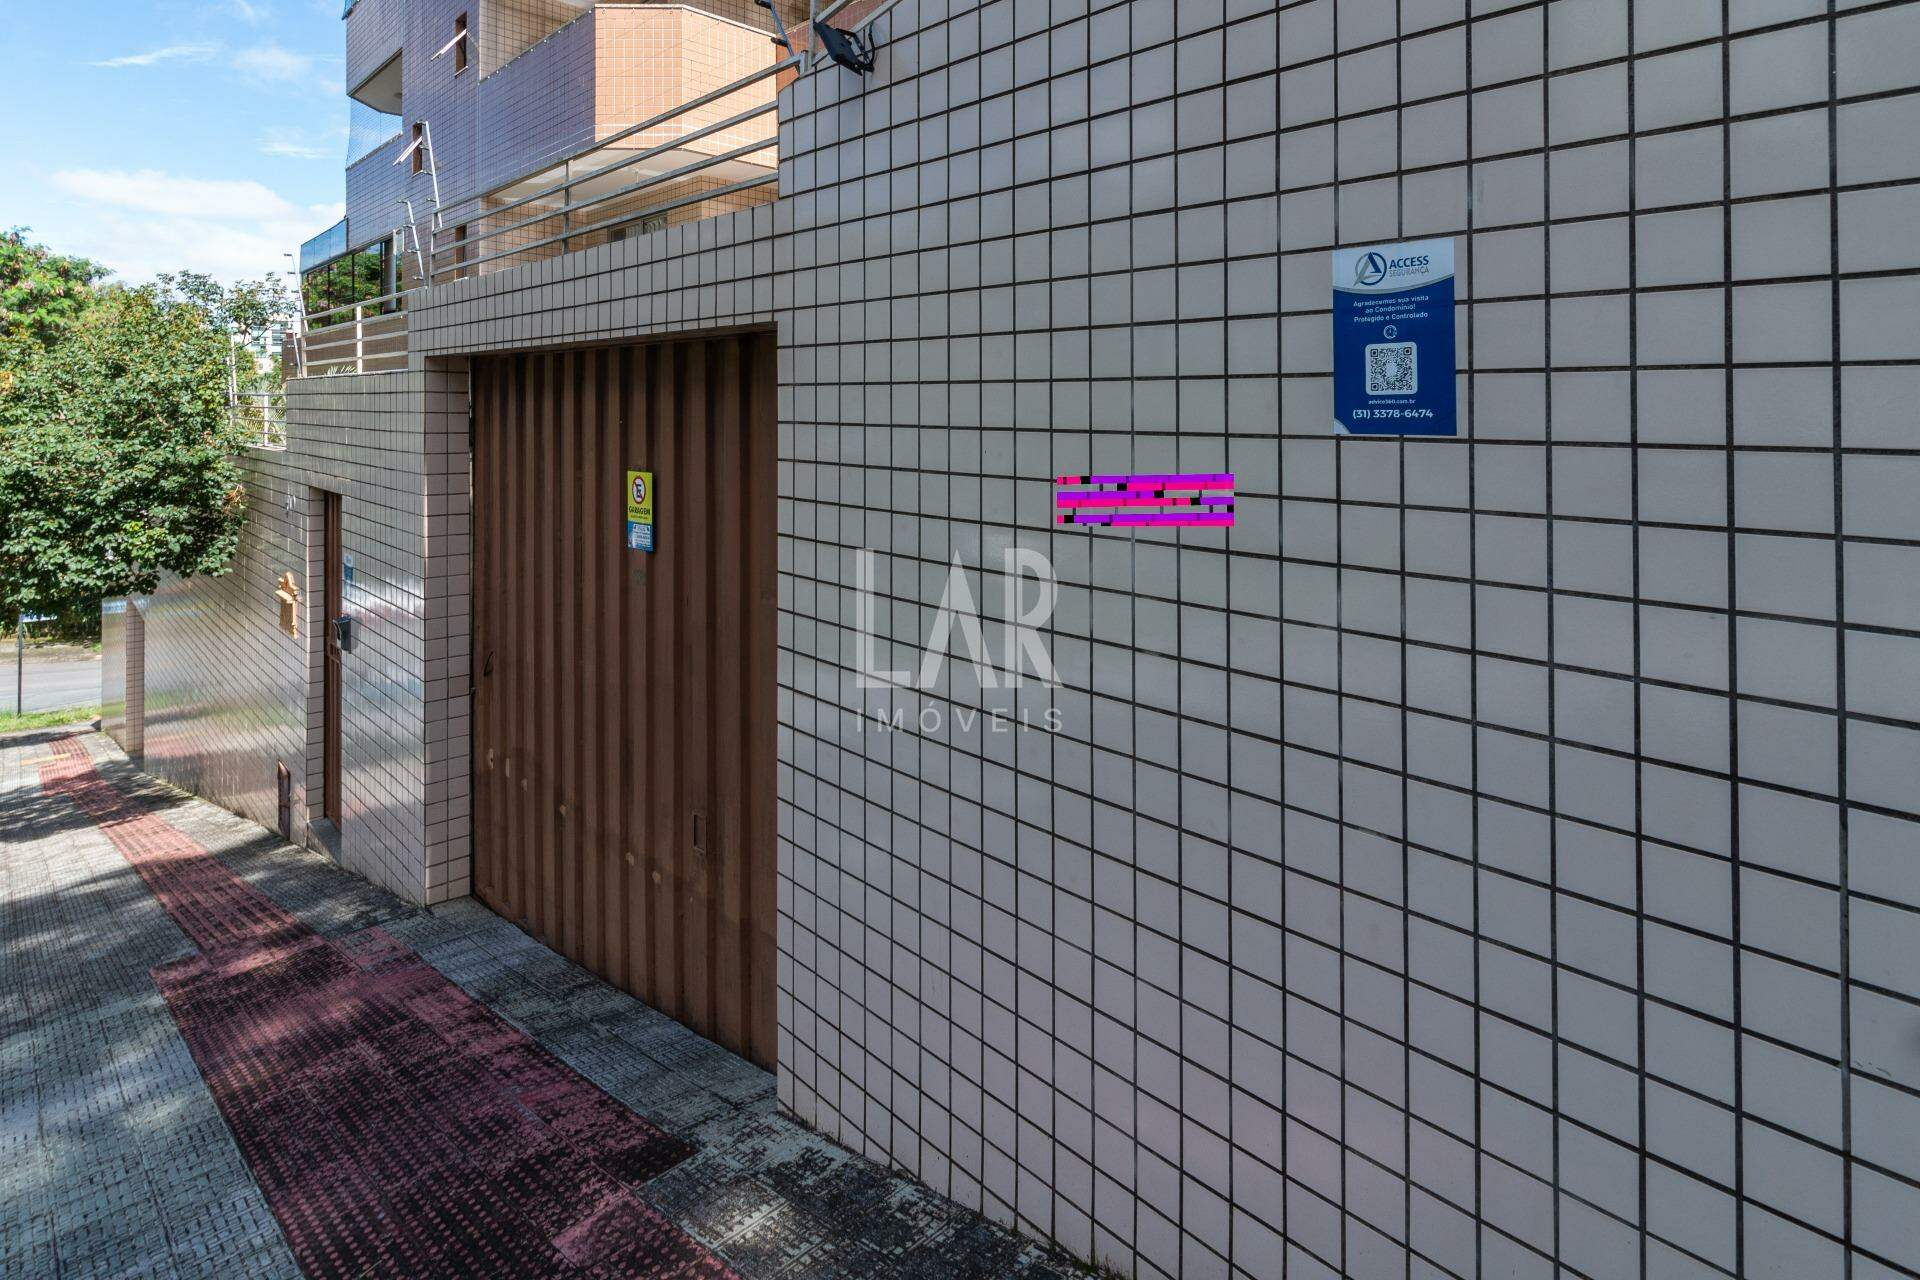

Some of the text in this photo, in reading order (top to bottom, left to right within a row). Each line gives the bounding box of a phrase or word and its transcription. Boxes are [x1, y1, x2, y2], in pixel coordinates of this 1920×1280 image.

[1389, 256, 1430, 269] ACCESS
[1389, 266, 1430, 278] SEGURANÇA
[1353, 298, 1396, 307] Agradecemos
[1353, 314, 1385, 323] Protegido
[1391, 312, 1428, 320] Controlado
[1352, 409, 1433, 419] (31) 3378-6474
[628, 505, 651, 515] GARAGEM
